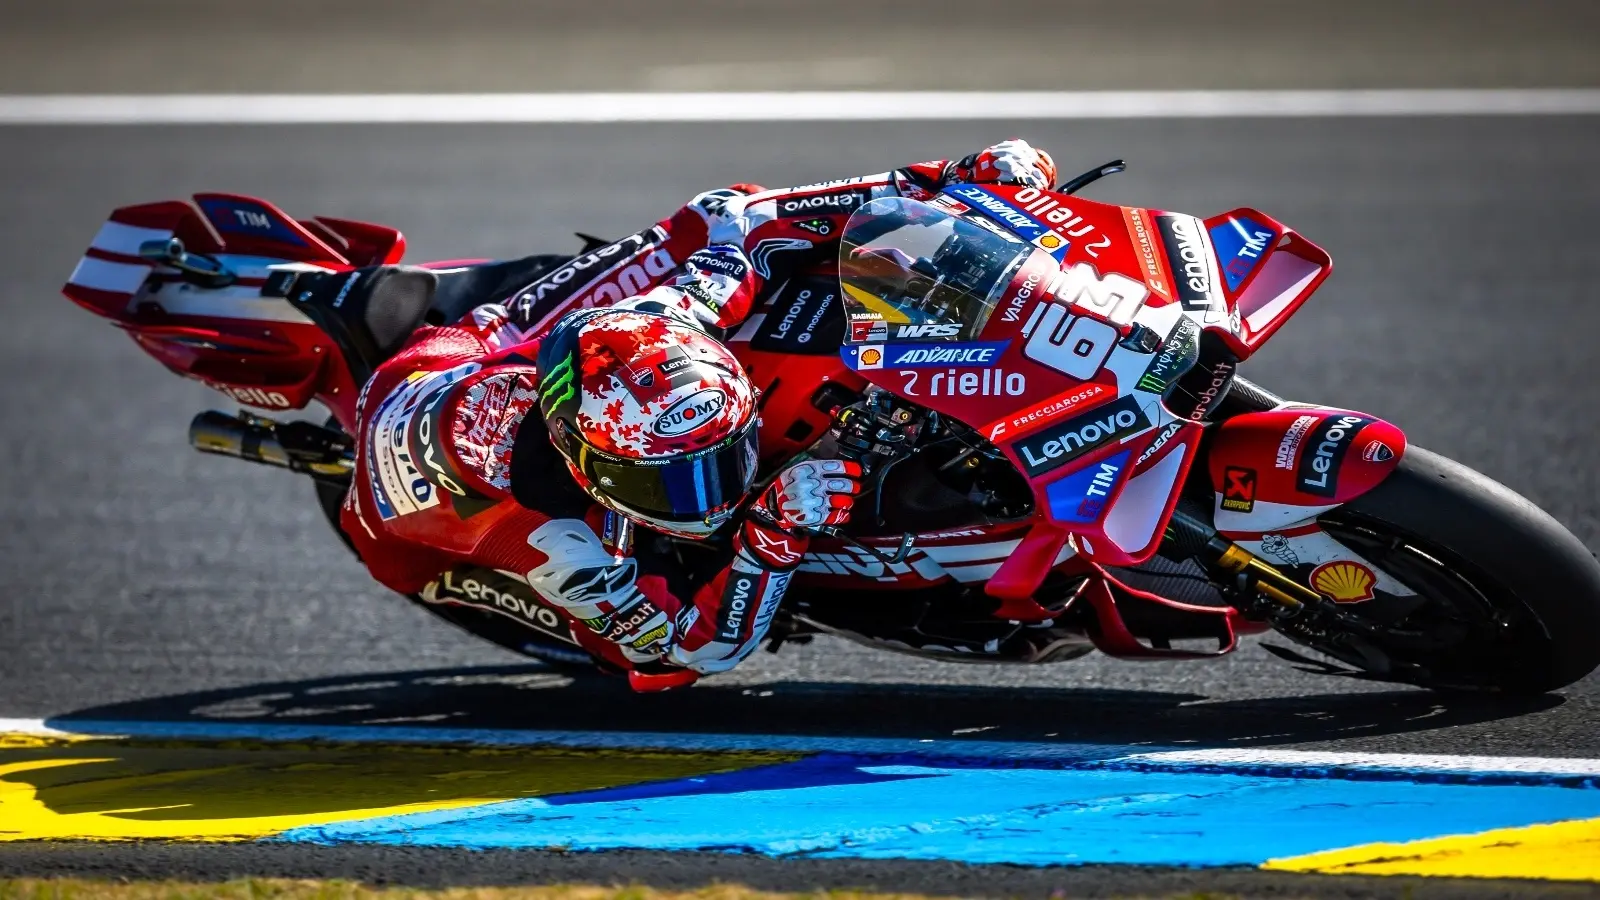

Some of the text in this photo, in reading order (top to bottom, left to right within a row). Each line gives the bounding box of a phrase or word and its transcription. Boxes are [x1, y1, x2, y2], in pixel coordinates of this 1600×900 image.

[234, 209, 271, 229] TIM
[784, 191, 865, 212] Lenovo
[954, 187, 1041, 229] ADVANCE
[1014, 187, 1095, 238] riello
[1130, 208, 1158, 276] FRECCIAROSSA
[1171, 219, 1214, 306] Lenovo
[1237, 231, 1272, 260] TIM
[517, 234, 643, 312] Lenovo
[582, 248, 677, 309] DUC
[688, 254, 736, 273] LIMOLAN
[770, 289, 812, 340] Lenovo
[807, 294, 835, 332] motorola
[1001, 266, 1046, 323] VARGRO
[851, 312, 883, 320] BAGNAIA
[896, 323, 963, 338] WRS
[662, 357, 693, 371] Leno
[894, 347, 996, 364] ADVANCE
[930, 369, 1026, 396] riello
[659, 395, 724, 430] SUOMY
[1012, 386, 1103, 427] FRECCIAROSSA
[420, 384, 466, 496] novo
[1021, 409, 1137, 467] Lenovo
[1136, 423, 1182, 465] RRERA
[1304, 416, 1362, 488] Lenovo
[1365, 441, 1379, 459] DUCATI
[1086, 463, 1119, 497] TIM
[444, 570, 559, 628] Lenovo
[722, 577, 752, 640] Lenovo
[754, 571, 791, 629] Unipol
[606, 602, 655, 641] ruba.it
